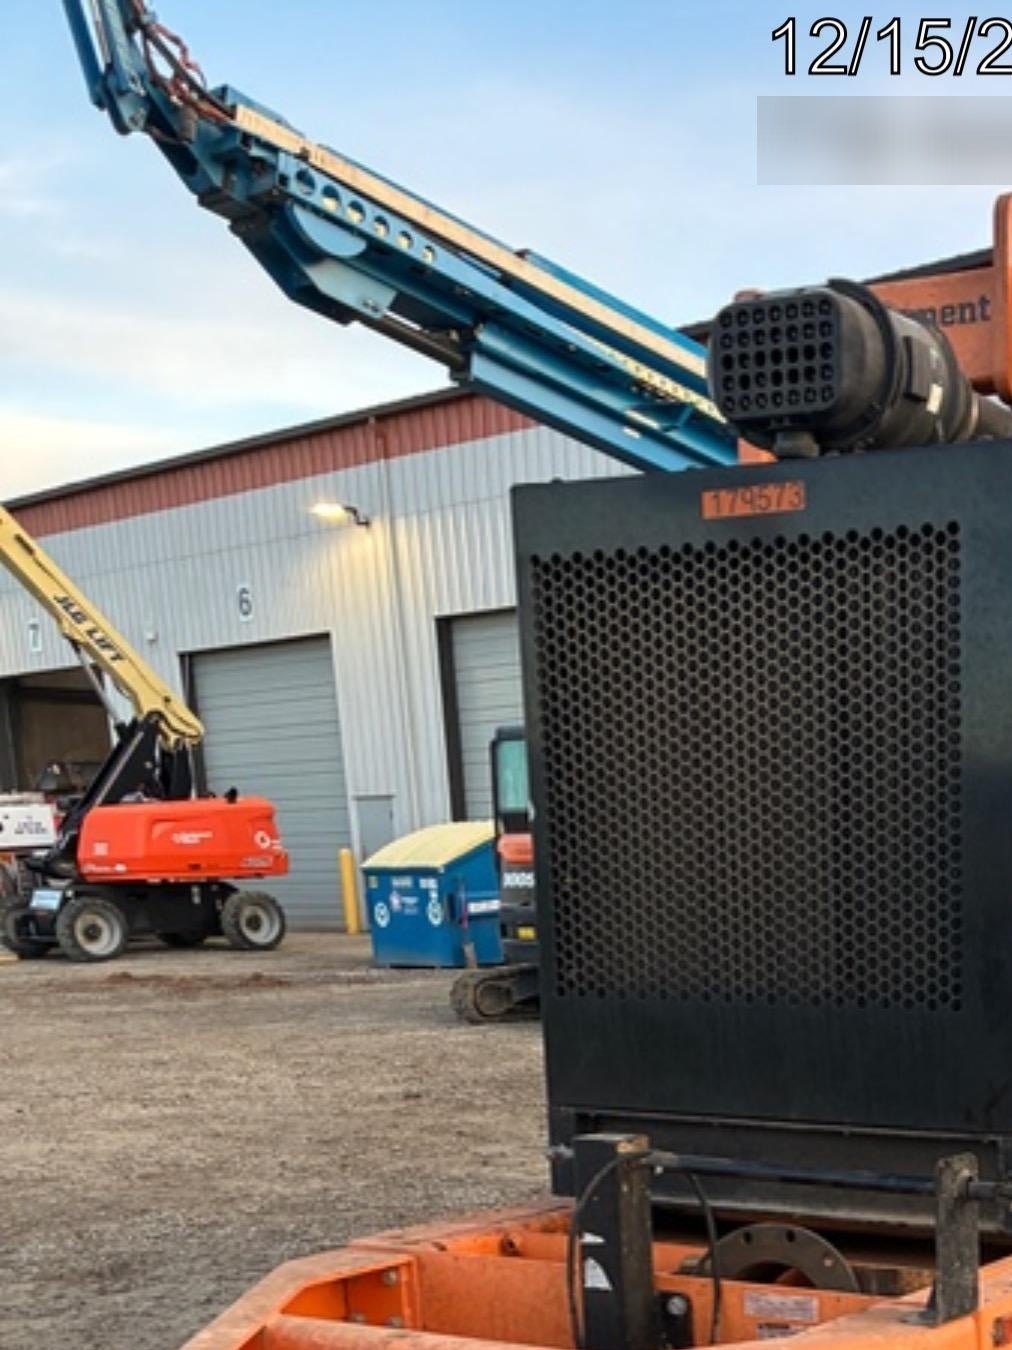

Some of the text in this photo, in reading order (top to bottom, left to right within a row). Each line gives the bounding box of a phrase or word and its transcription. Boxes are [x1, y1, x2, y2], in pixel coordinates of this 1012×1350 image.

[238, 587, 252, 616] 6
[53, 595, 126, 662] JLG LIFT
